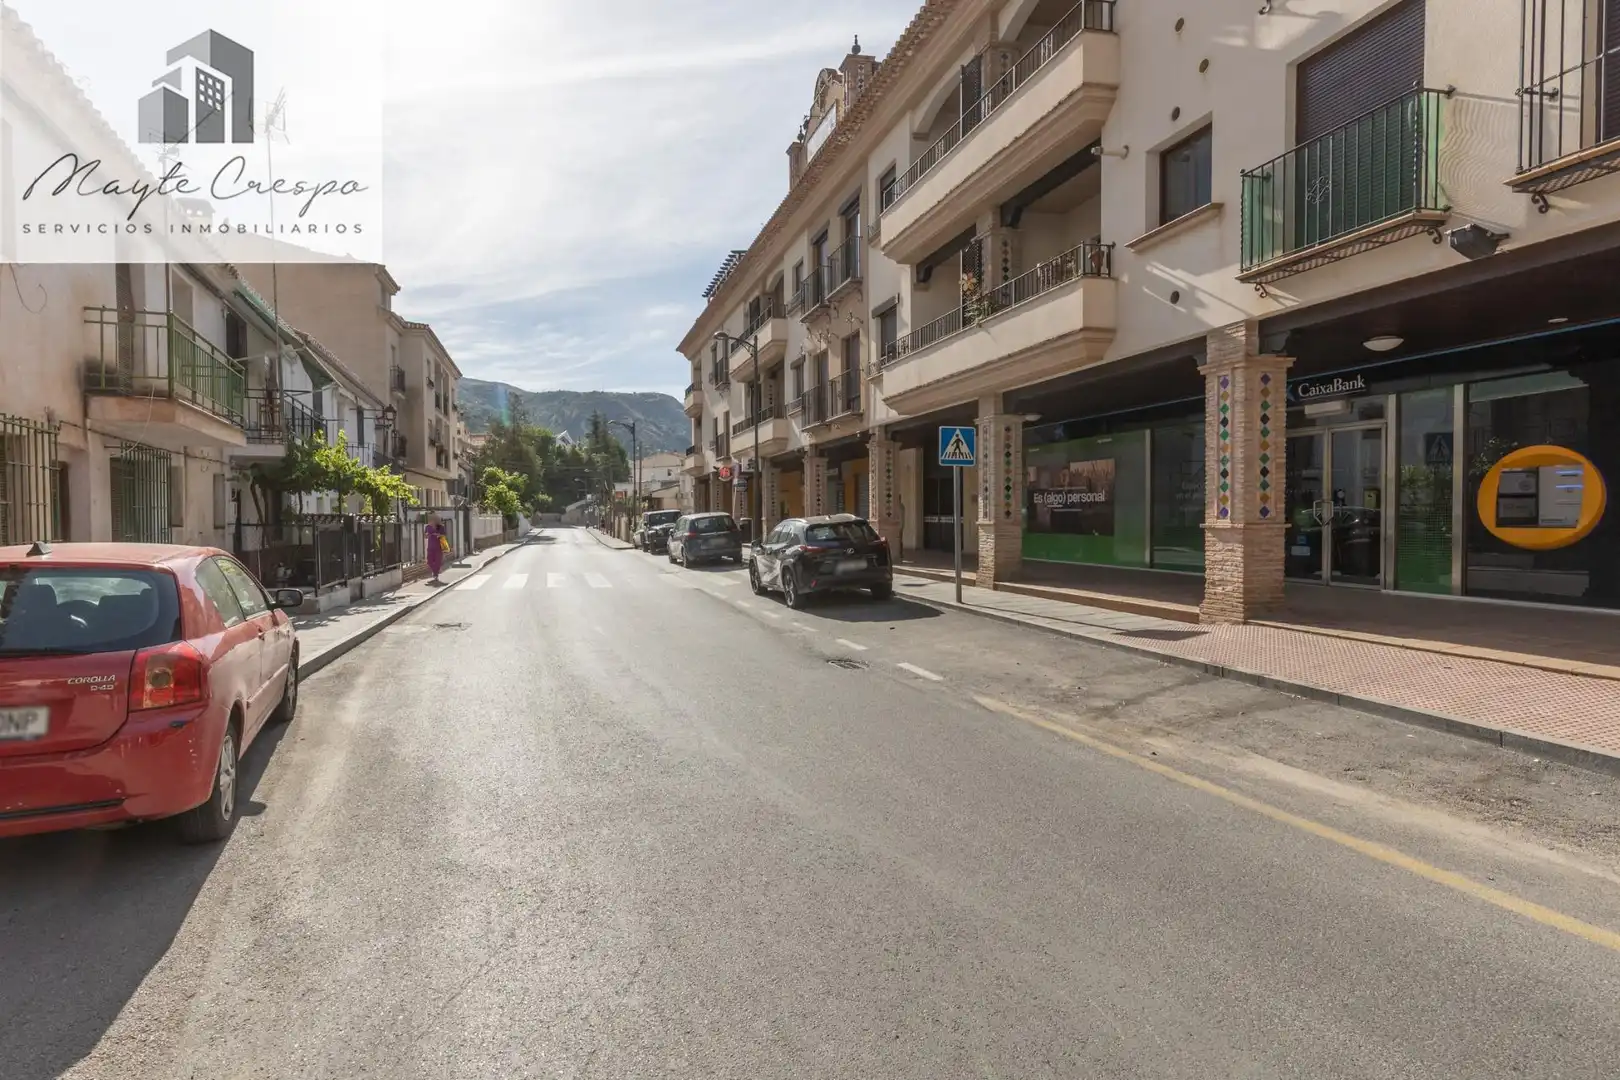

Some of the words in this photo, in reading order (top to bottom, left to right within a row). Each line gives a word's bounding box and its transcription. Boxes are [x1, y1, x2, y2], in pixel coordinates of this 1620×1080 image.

[1298, 374, 1366, 397] CaixaBank
[1034, 493, 1043, 504] Es
[1044, 491, 1066, 505] (algo)
[1067, 490, 1105, 505] personal
[67, 674, 116, 685] COROLLA
